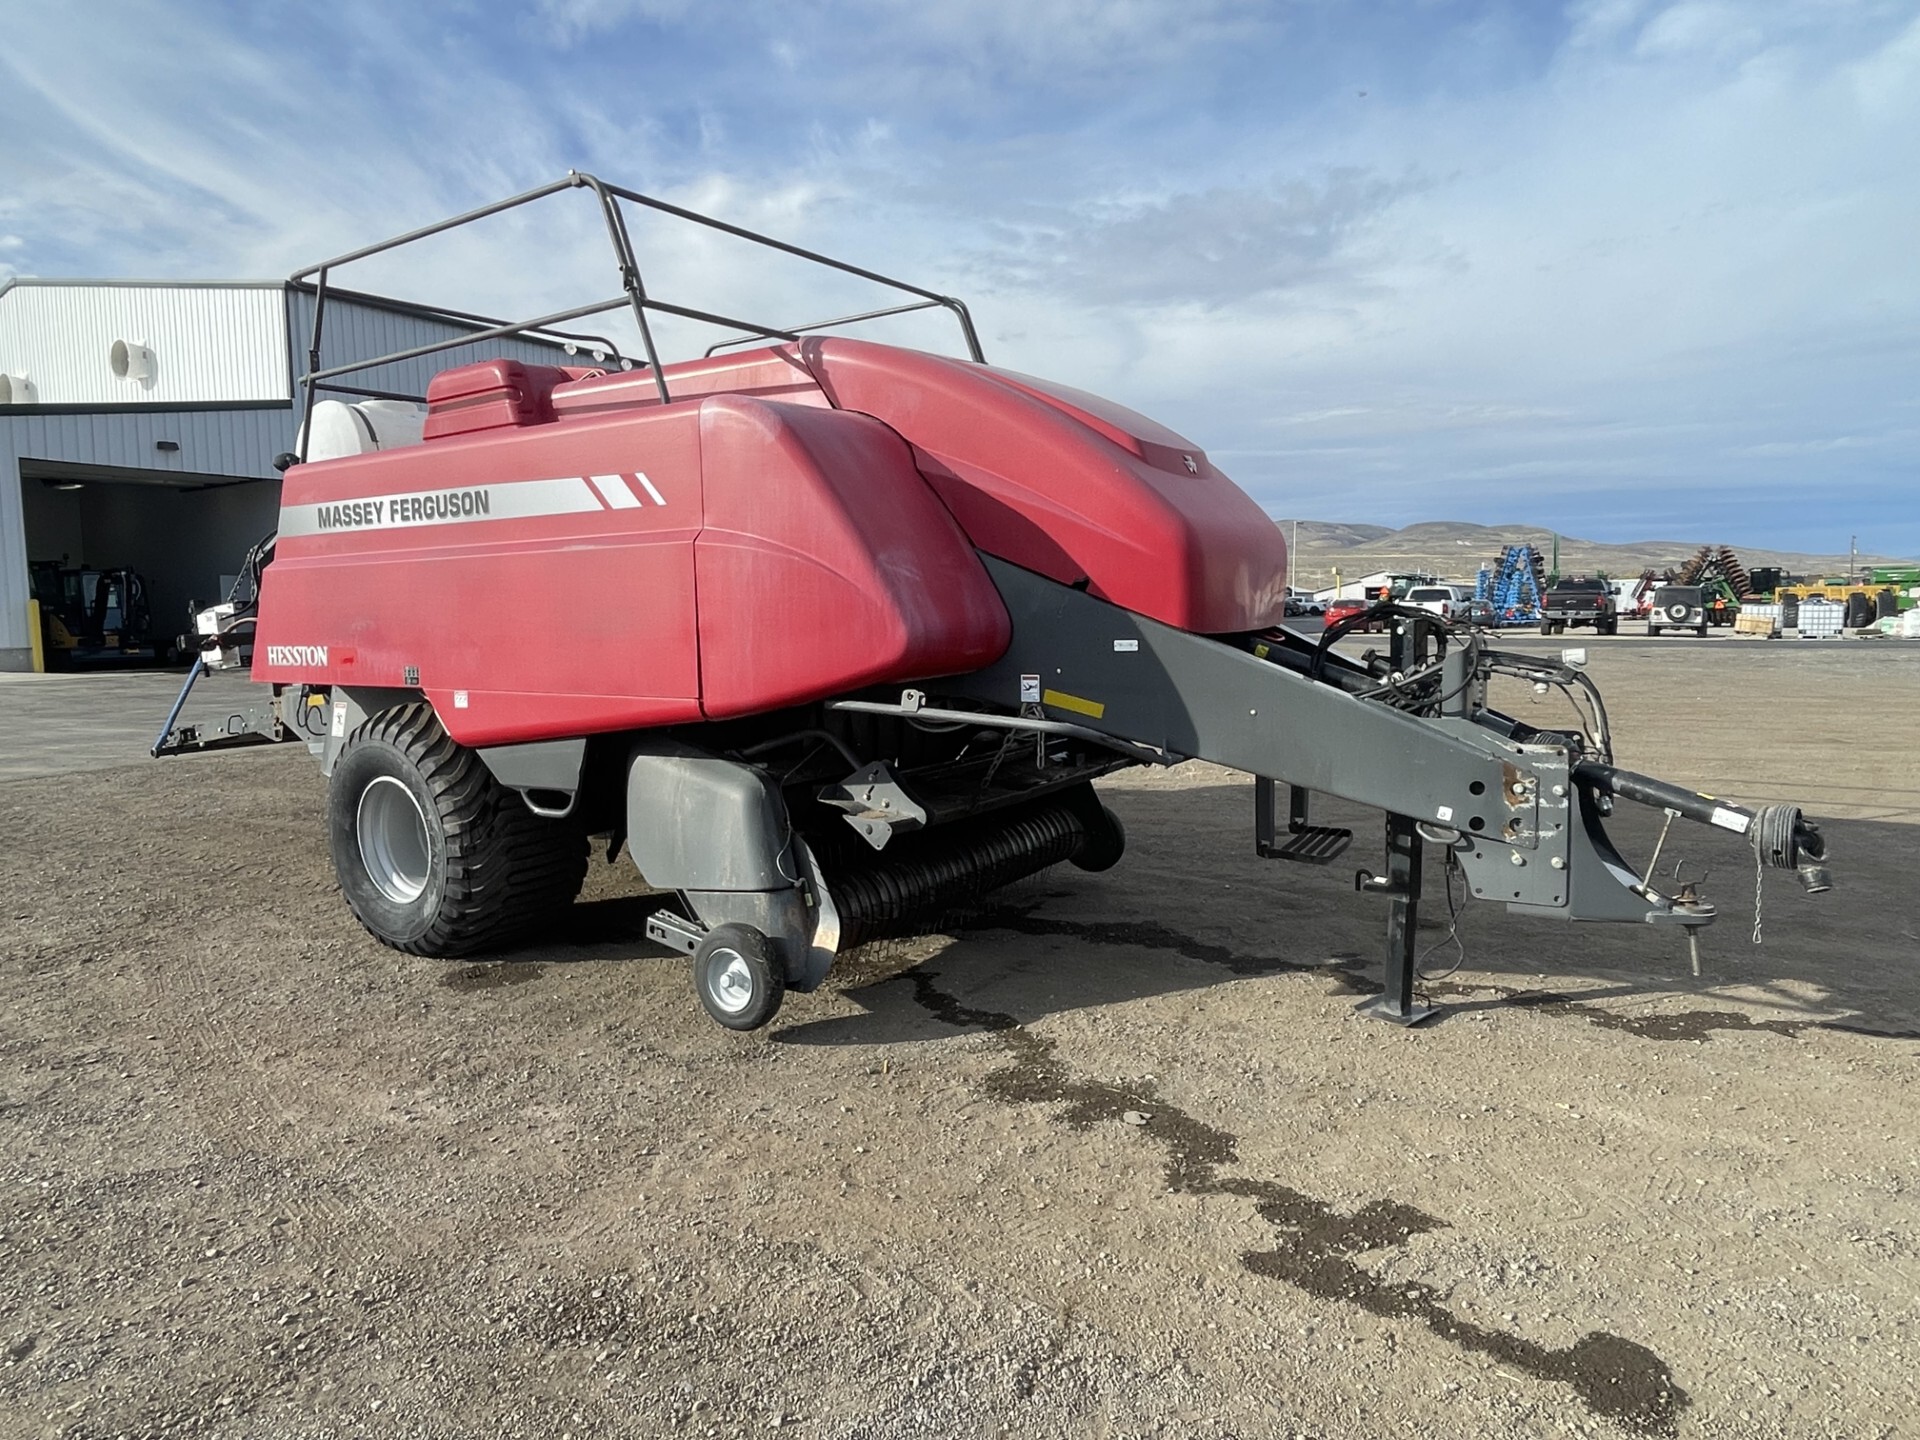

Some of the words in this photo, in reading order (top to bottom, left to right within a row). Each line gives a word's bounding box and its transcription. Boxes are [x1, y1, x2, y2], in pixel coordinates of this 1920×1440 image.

[318, 501, 384, 528] MASSEY
[390, 490, 489, 523] FERGUSON
[267, 646, 328, 667] HESSTON
